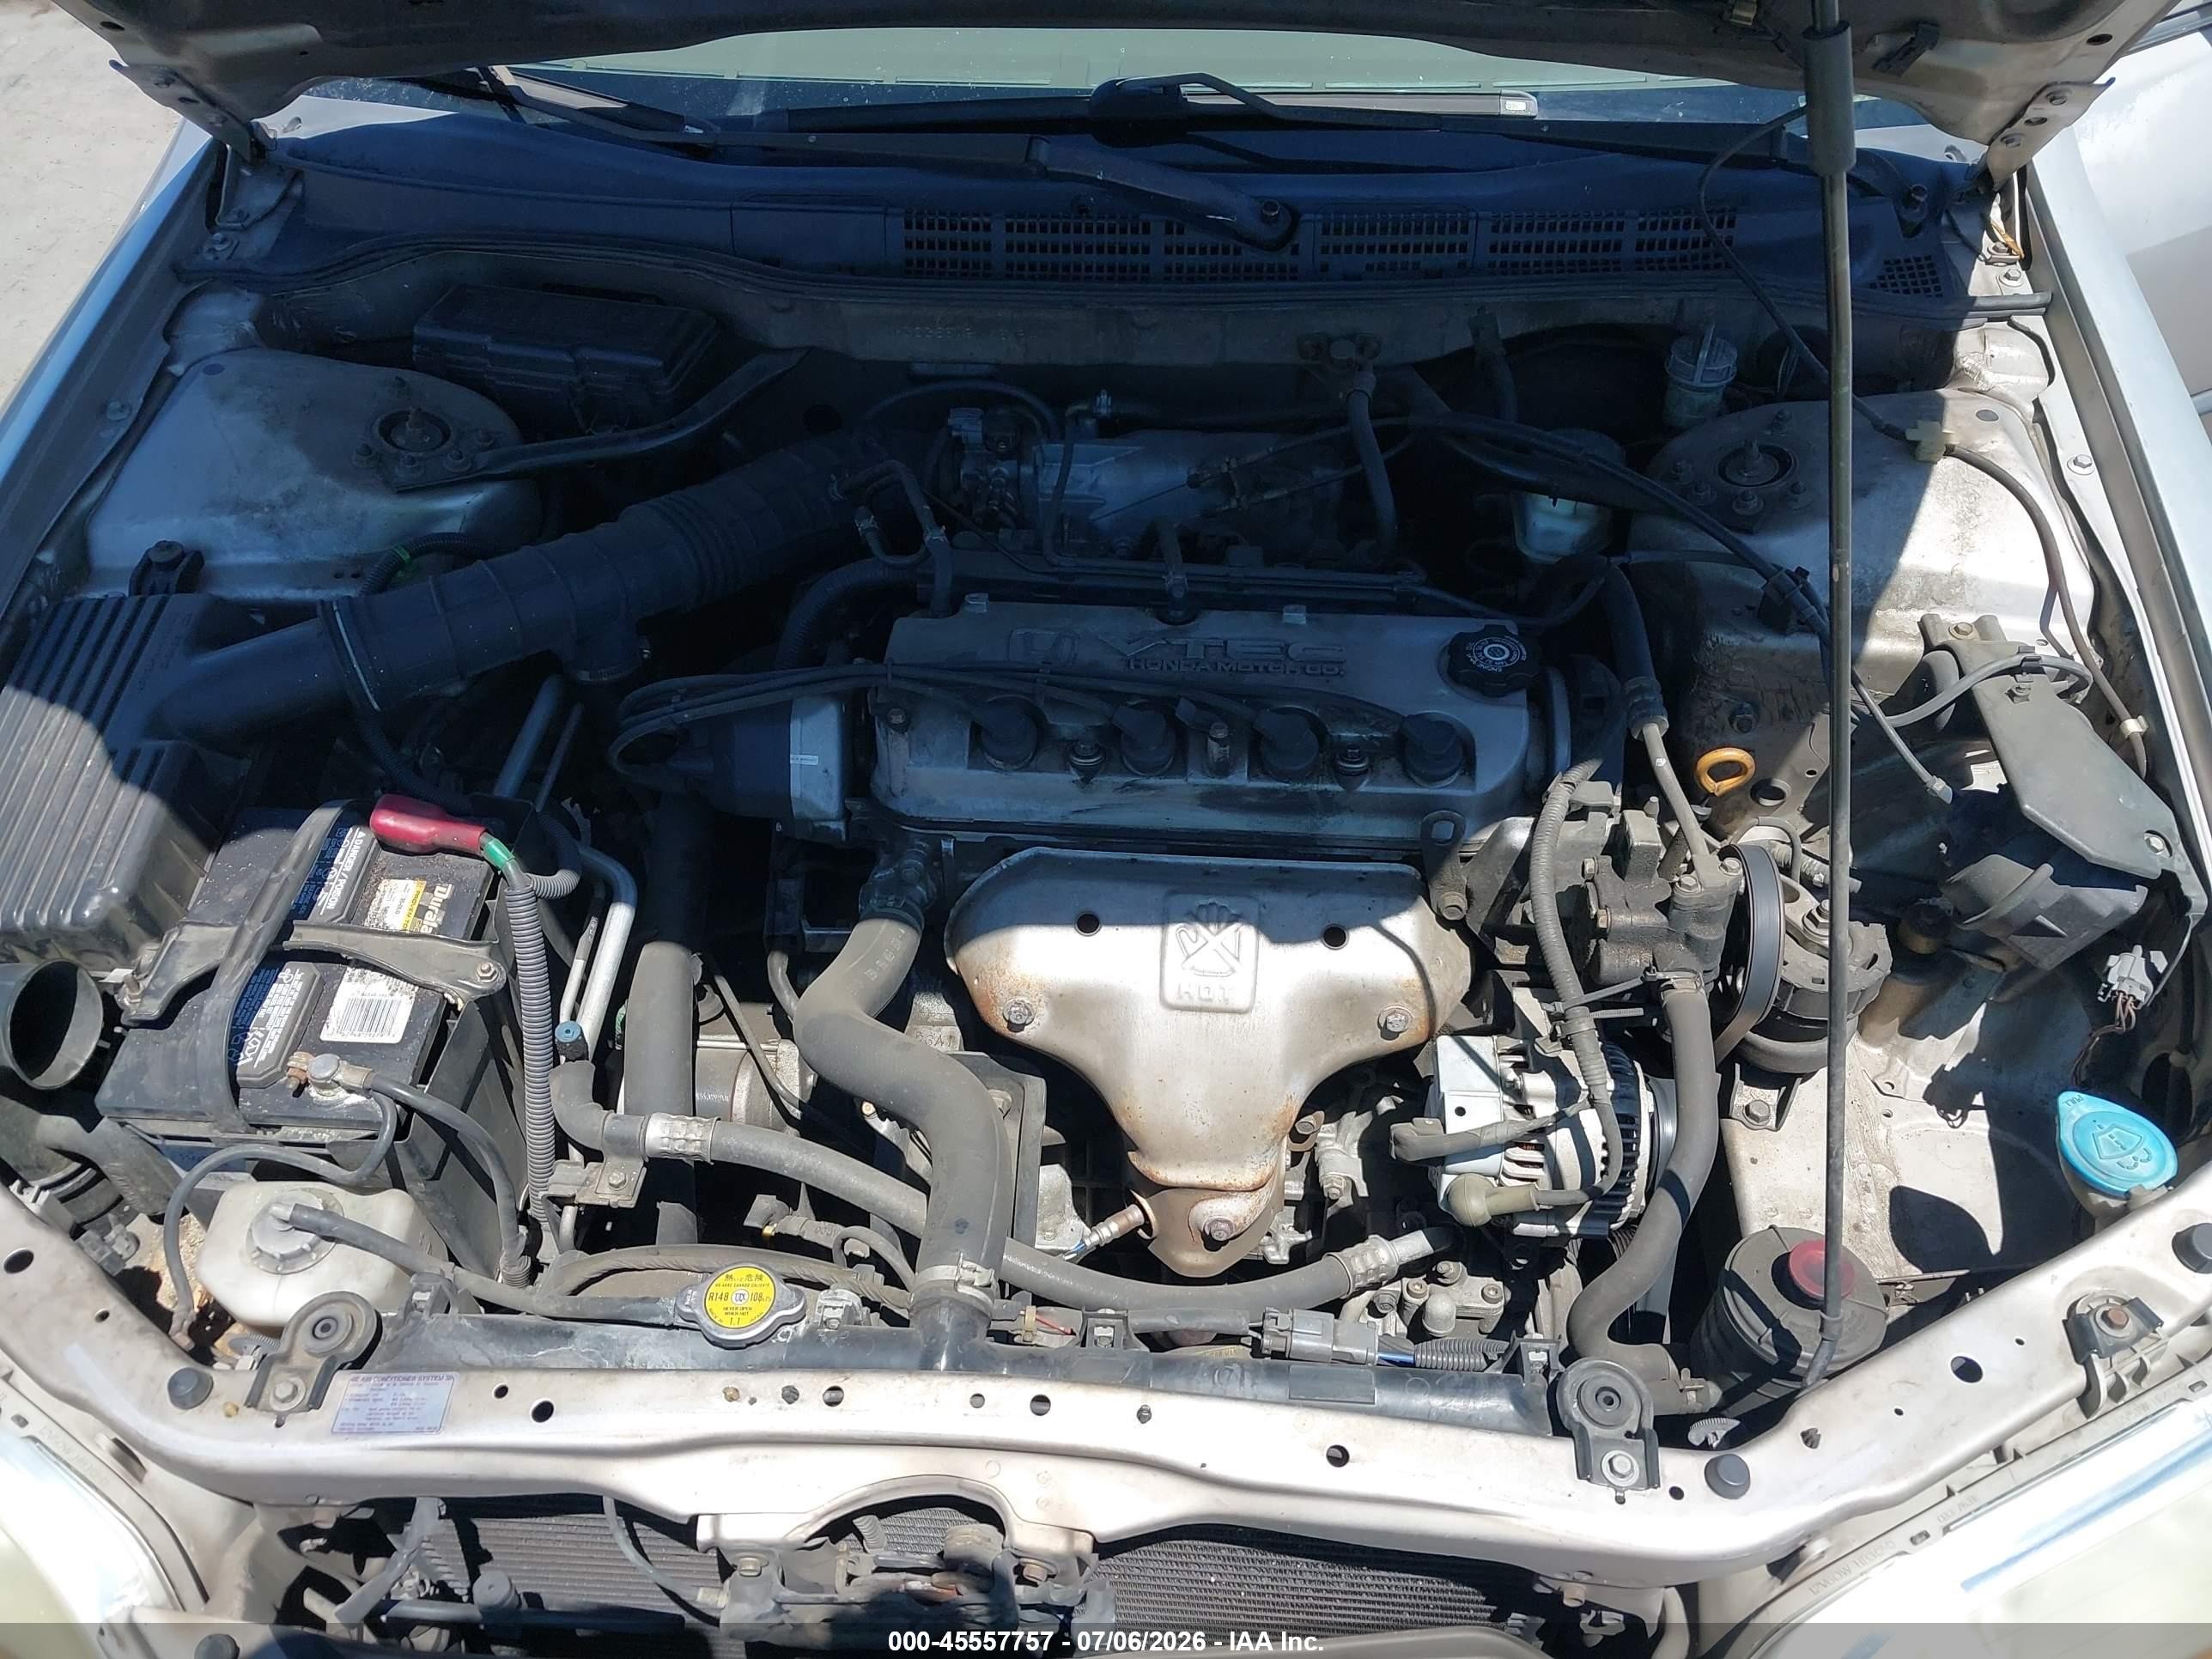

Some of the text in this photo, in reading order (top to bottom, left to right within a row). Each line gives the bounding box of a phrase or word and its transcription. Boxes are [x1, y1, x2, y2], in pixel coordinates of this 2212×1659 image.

[1099, 635, 1346, 663] VTEC
[1129, 659, 1212, 672] HONDA
[1218, 660, 1300, 675] MOTOR
[343, 839, 362, 872] DANGER
[327, 878, 347, 909] POISON
[406, 890, 421, 919] PROVEN
[420, 883, 453, 933] Durala
[1178, 983, 1234, 1004] HOT
[2062, 1094, 2085, 1107] PULL
[708, 1291, 729, 1302] R148
